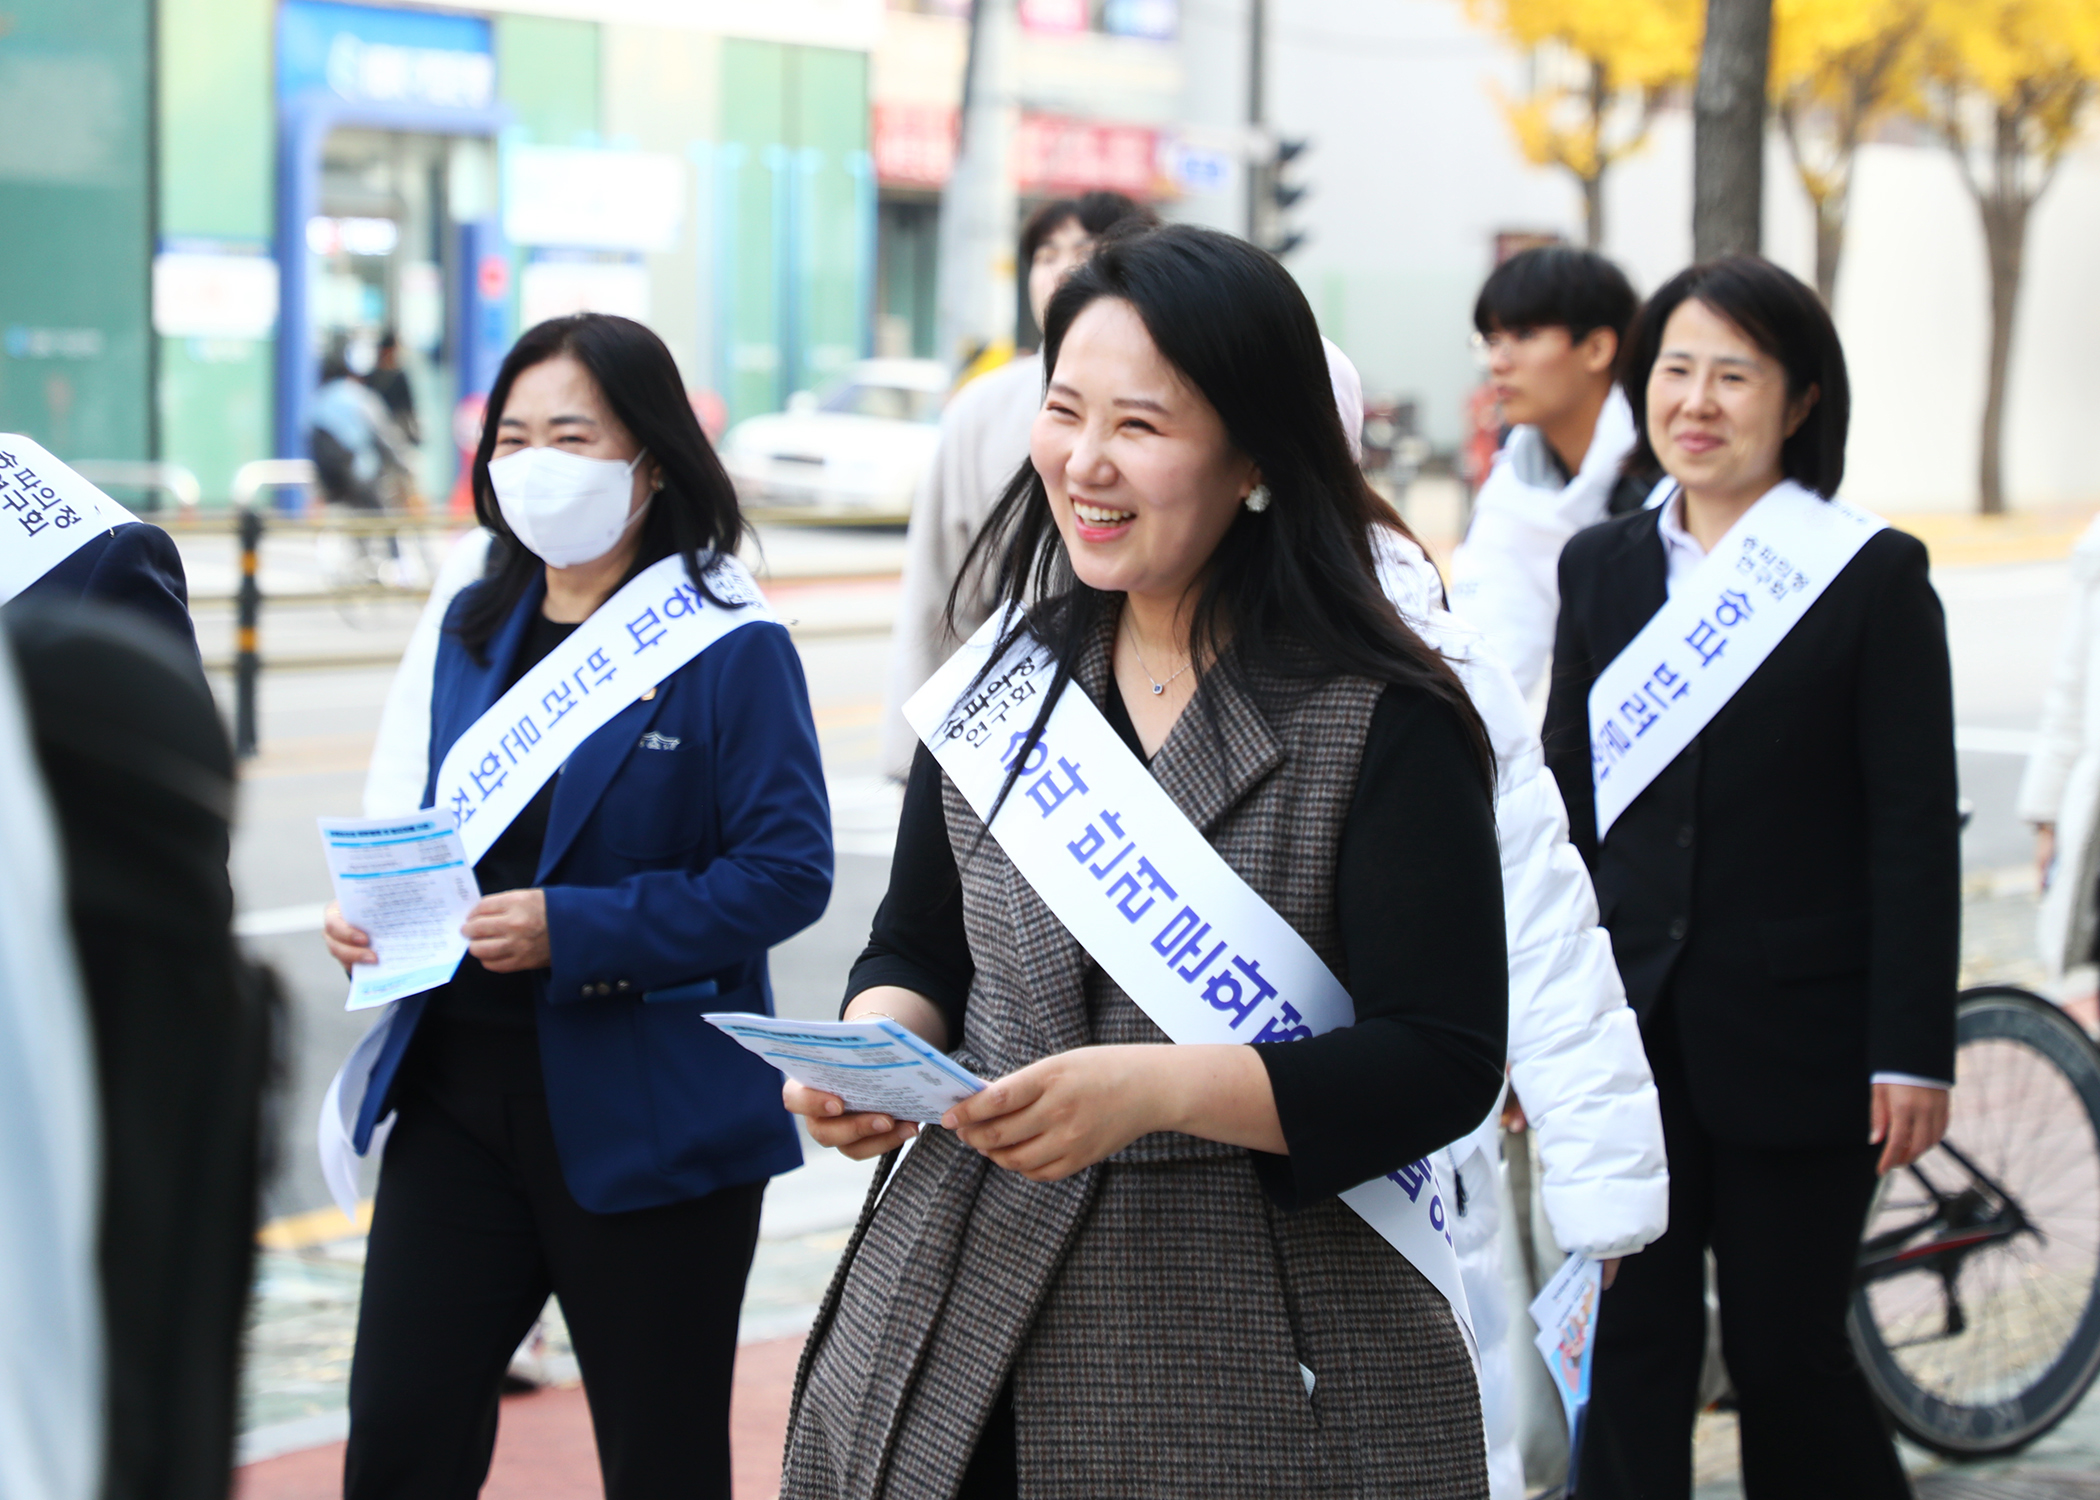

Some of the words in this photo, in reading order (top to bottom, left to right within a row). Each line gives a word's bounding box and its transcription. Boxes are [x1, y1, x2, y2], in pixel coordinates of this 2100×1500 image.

[0, 450, 82, 529] 송파의정
[626, 583, 704, 655] 송파
[1685, 589, 1754, 667] 송파
[965, 680, 1037, 749] 연구회
[1000, 726, 1090, 819] 송파
